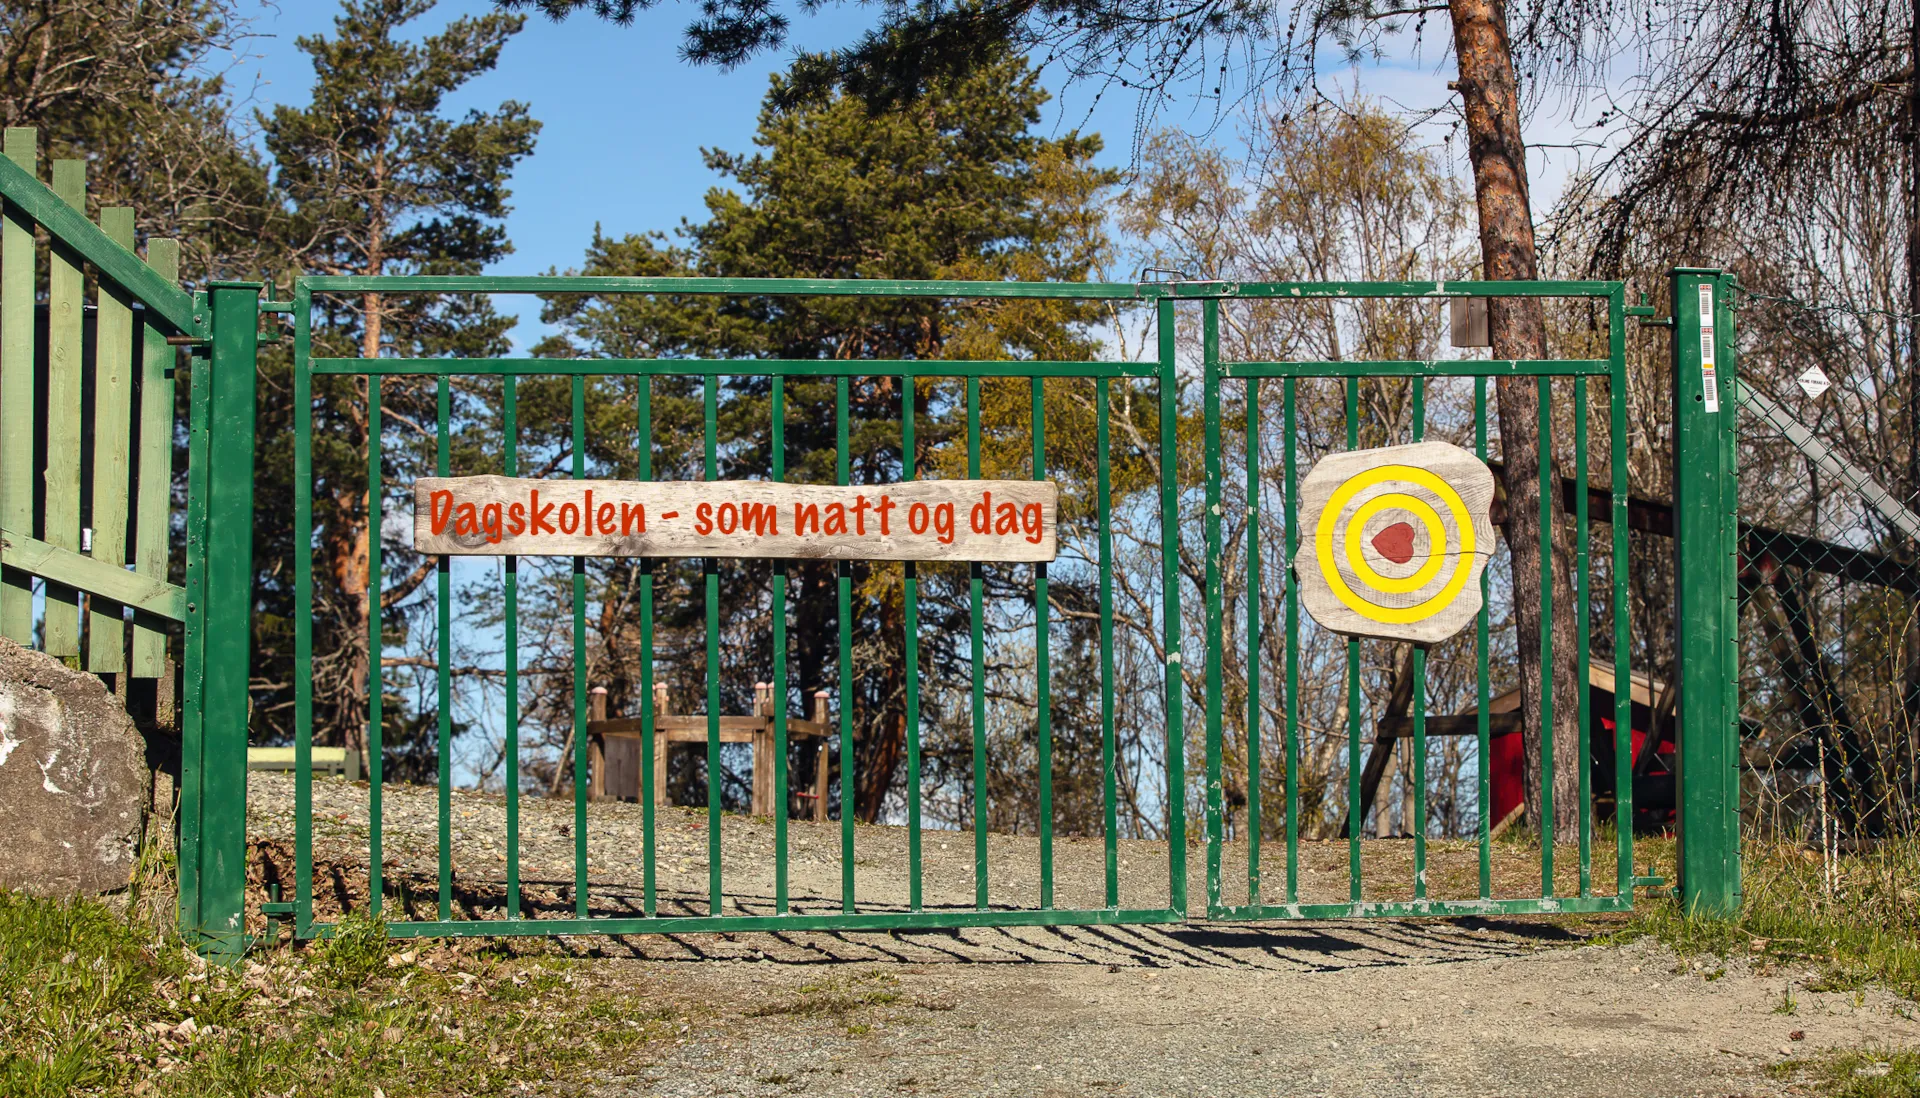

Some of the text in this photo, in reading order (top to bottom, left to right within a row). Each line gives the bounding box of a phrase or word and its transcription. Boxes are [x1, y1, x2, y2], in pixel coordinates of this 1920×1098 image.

[430, 489, 1044, 545] Dagskolen - som natt og dag
